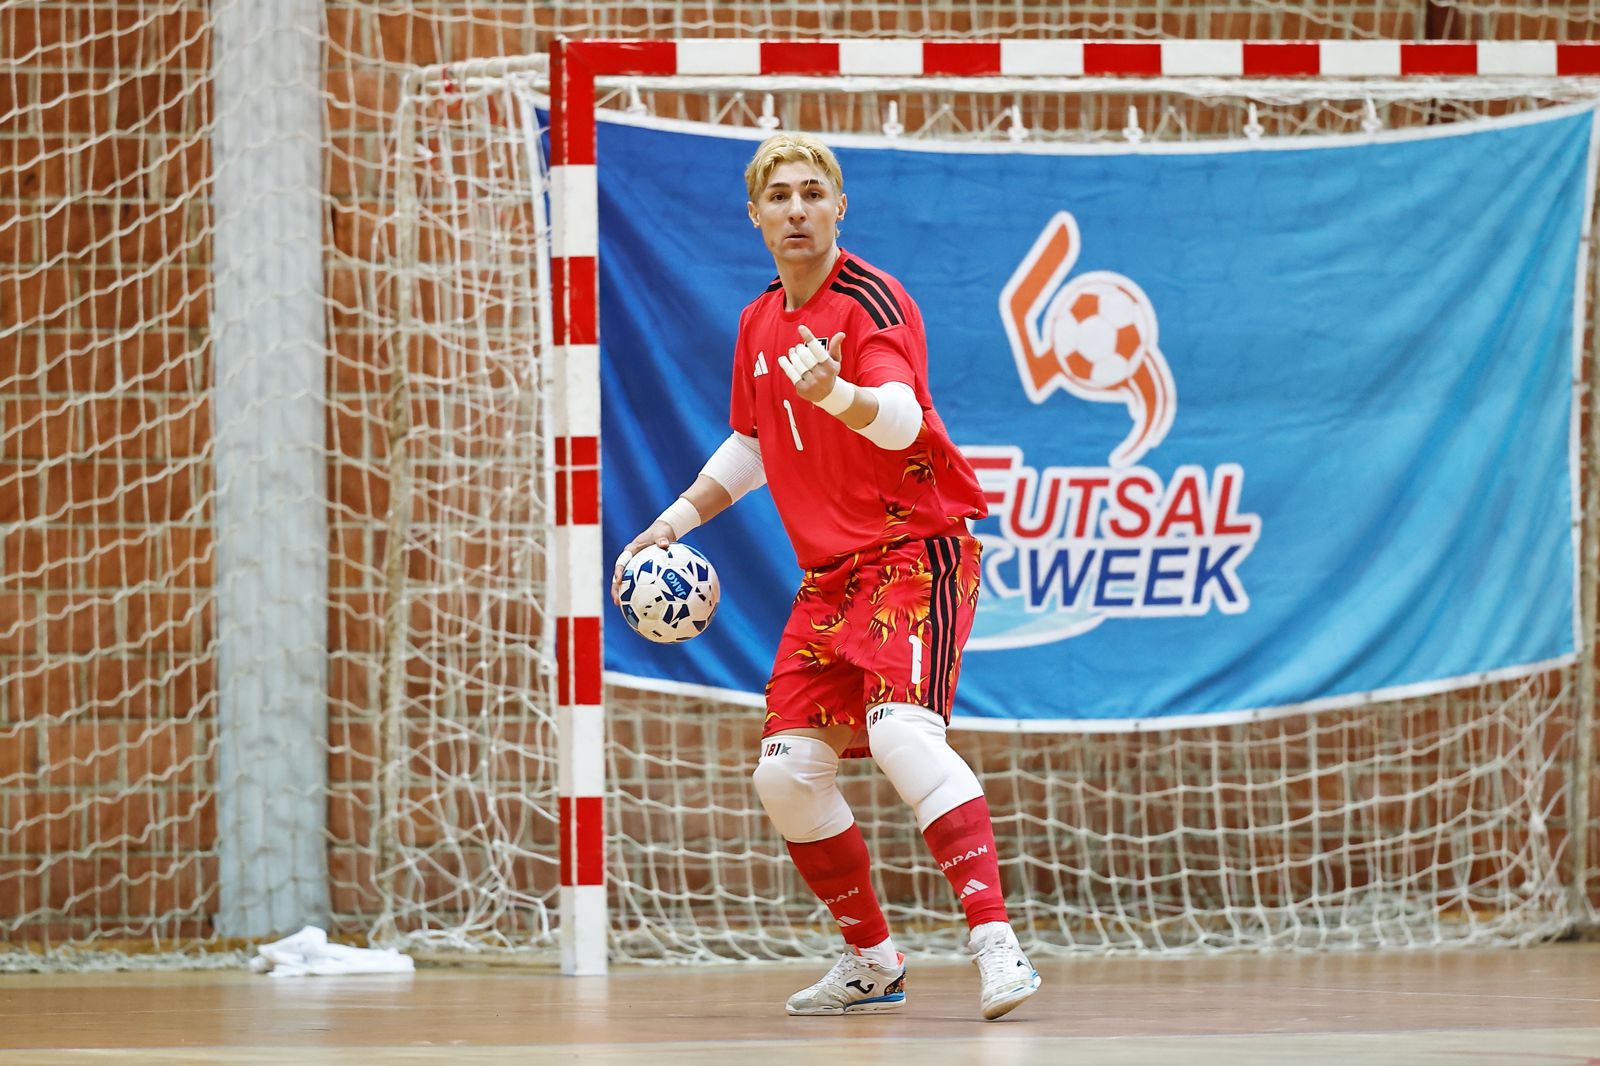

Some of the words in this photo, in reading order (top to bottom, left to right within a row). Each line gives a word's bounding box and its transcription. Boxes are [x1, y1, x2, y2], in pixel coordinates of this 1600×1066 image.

[783, 399, 803, 451] 1
[666, 572, 687, 597] JAKO
[1029, 546, 1242, 607] WEEK
[908, 634, 922, 684] 1
[940, 844, 988, 872] JAPAN
